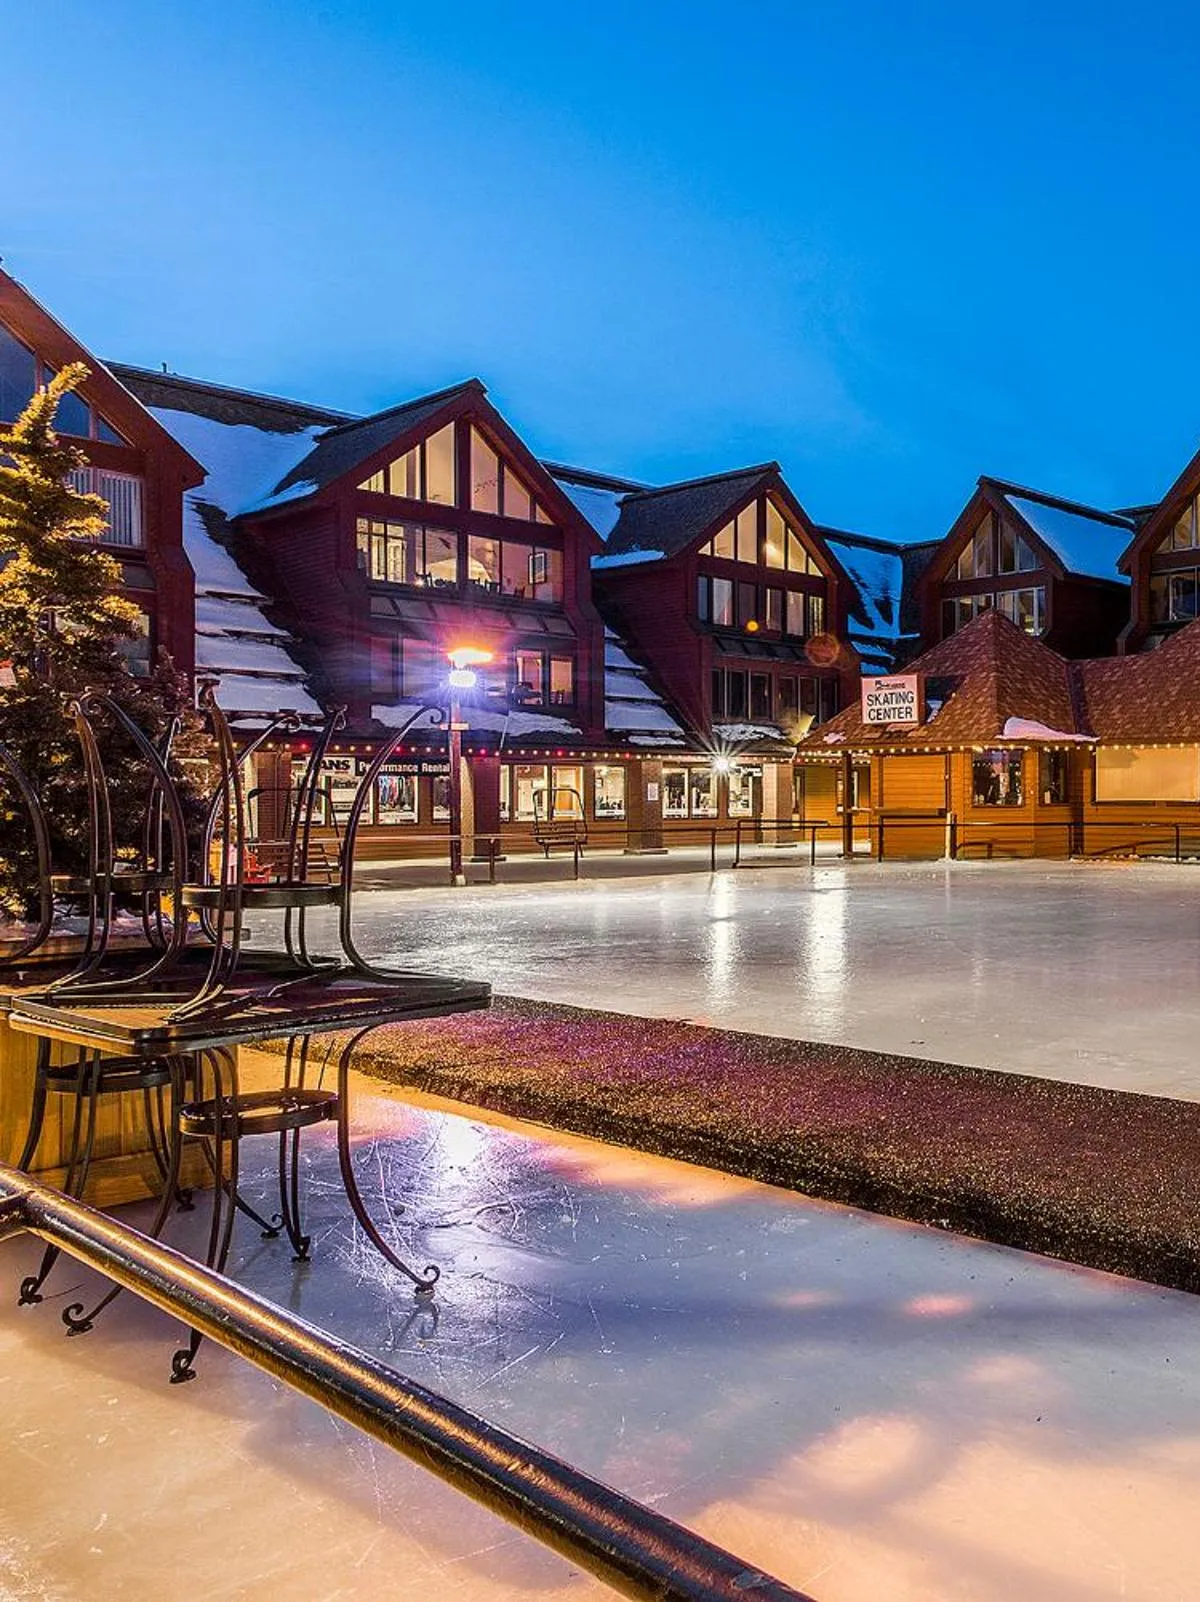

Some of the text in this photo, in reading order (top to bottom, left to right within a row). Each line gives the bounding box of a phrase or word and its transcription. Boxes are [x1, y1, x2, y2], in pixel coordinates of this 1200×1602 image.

[866, 691, 915, 707] SKATING
[868, 706, 913, 721] CENTER
[319, 759, 351, 770] ANS
